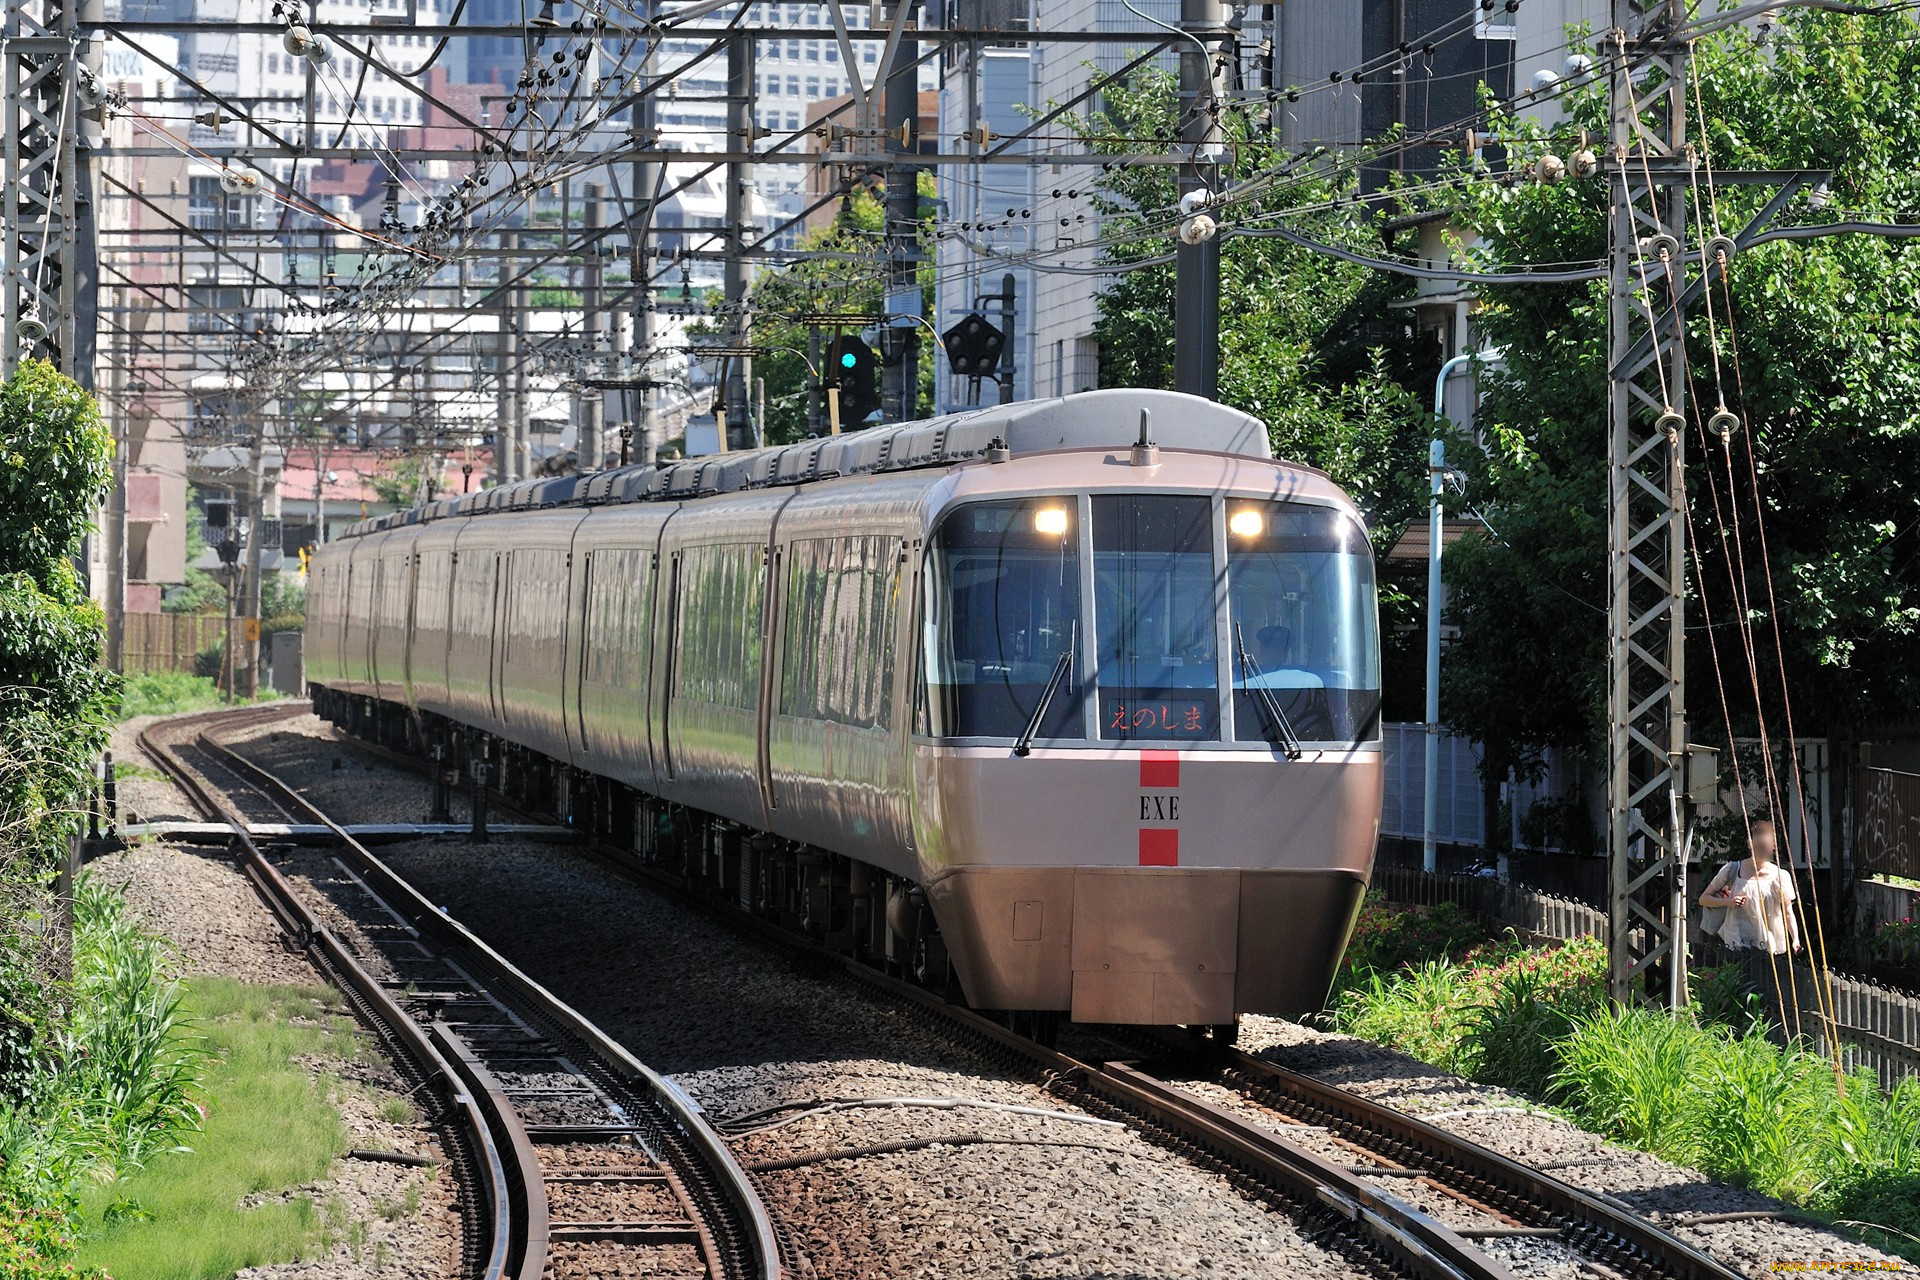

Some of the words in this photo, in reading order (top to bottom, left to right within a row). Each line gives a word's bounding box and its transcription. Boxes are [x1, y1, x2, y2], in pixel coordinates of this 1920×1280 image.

[1111, 706, 1202, 730] えのしま
[1140, 796, 1179, 820] EXE
